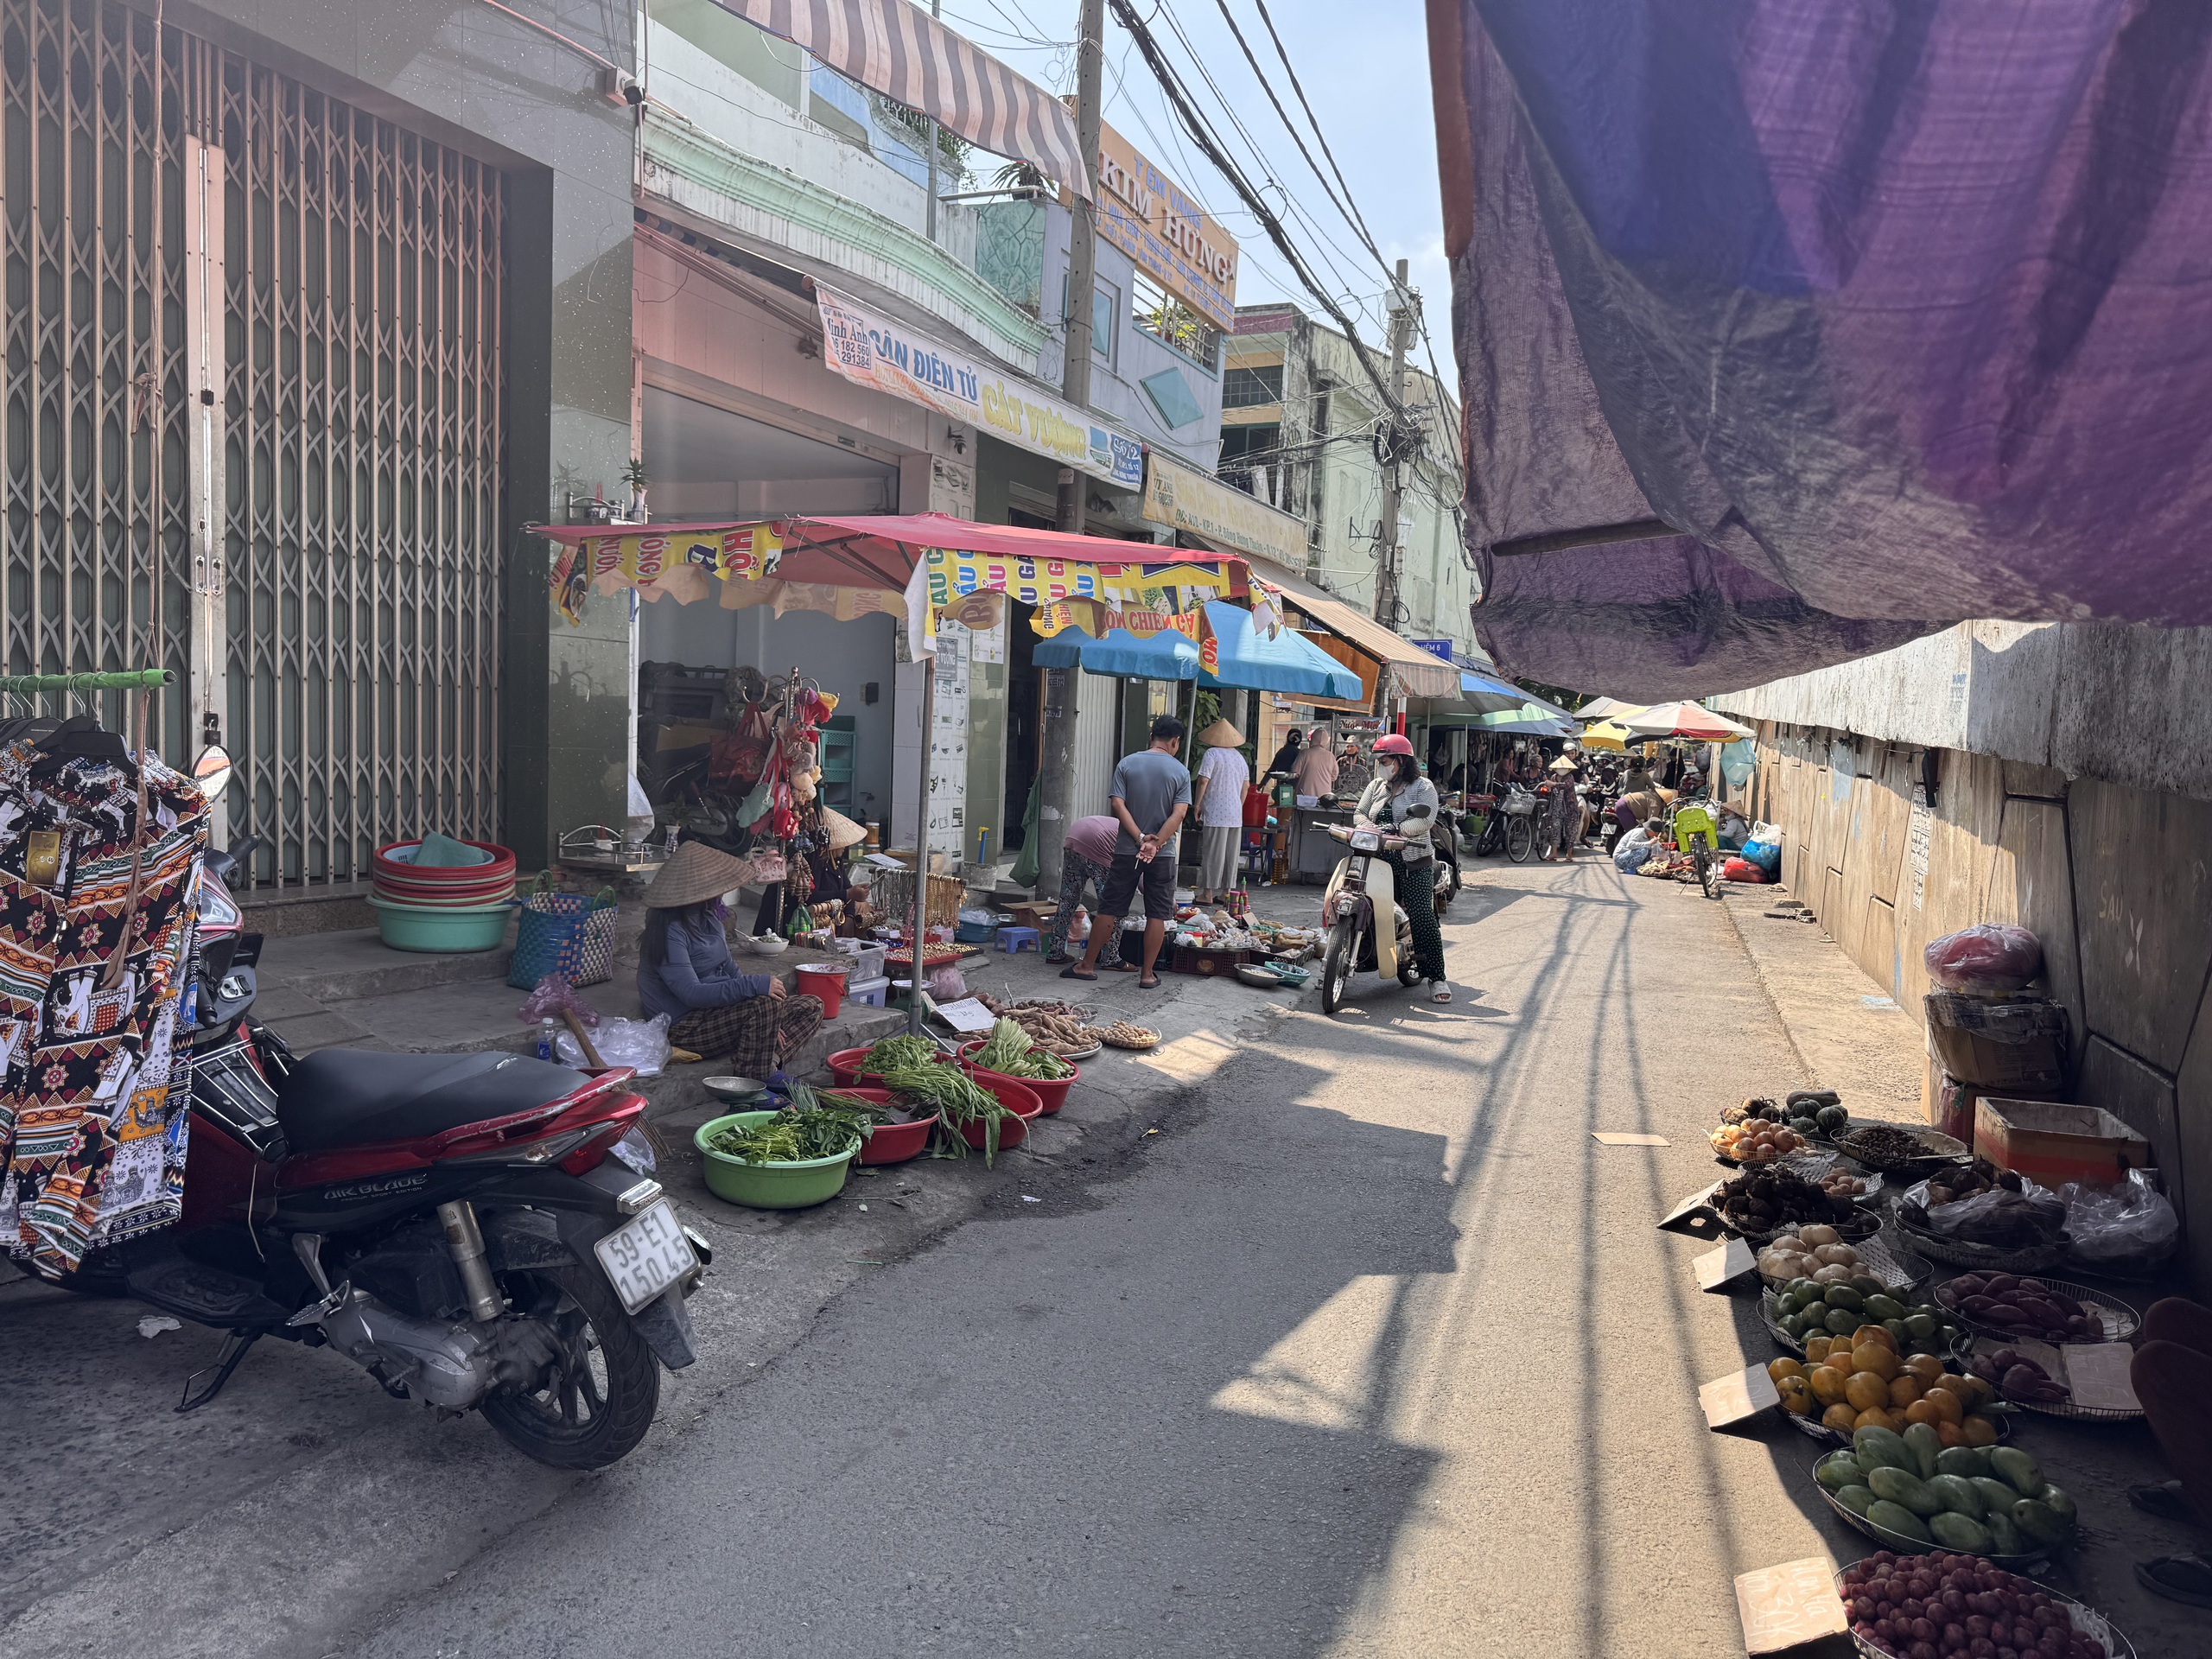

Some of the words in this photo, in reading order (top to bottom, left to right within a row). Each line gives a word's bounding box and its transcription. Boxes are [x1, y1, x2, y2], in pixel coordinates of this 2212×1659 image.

[1098, 149, 1154, 225] KIM
[1160, 206, 1229, 285] HƯNG
[1169, 186, 1202, 231] VÀNG
[841, 340, 855, 353] 182
[857, 344, 870, 357] 560
[913, 348, 955, 393] ĐIỆN
[957, 365, 978, 402] TỬ
[1024, 404, 1087, 461] VƯỢNG
[1113, 438, 1128, 456] Số
[1127, 444, 1140, 461] 12
[594, 537, 624, 575] NƯỚN
[323, 1185, 358, 1200] AIR
[359, 1174, 429, 1194] BLADE
[395, 1186, 423, 1195] EDITION
[607, 1211, 669, 1268] 59-E1
[620, 1235, 691, 1303] 150.45
